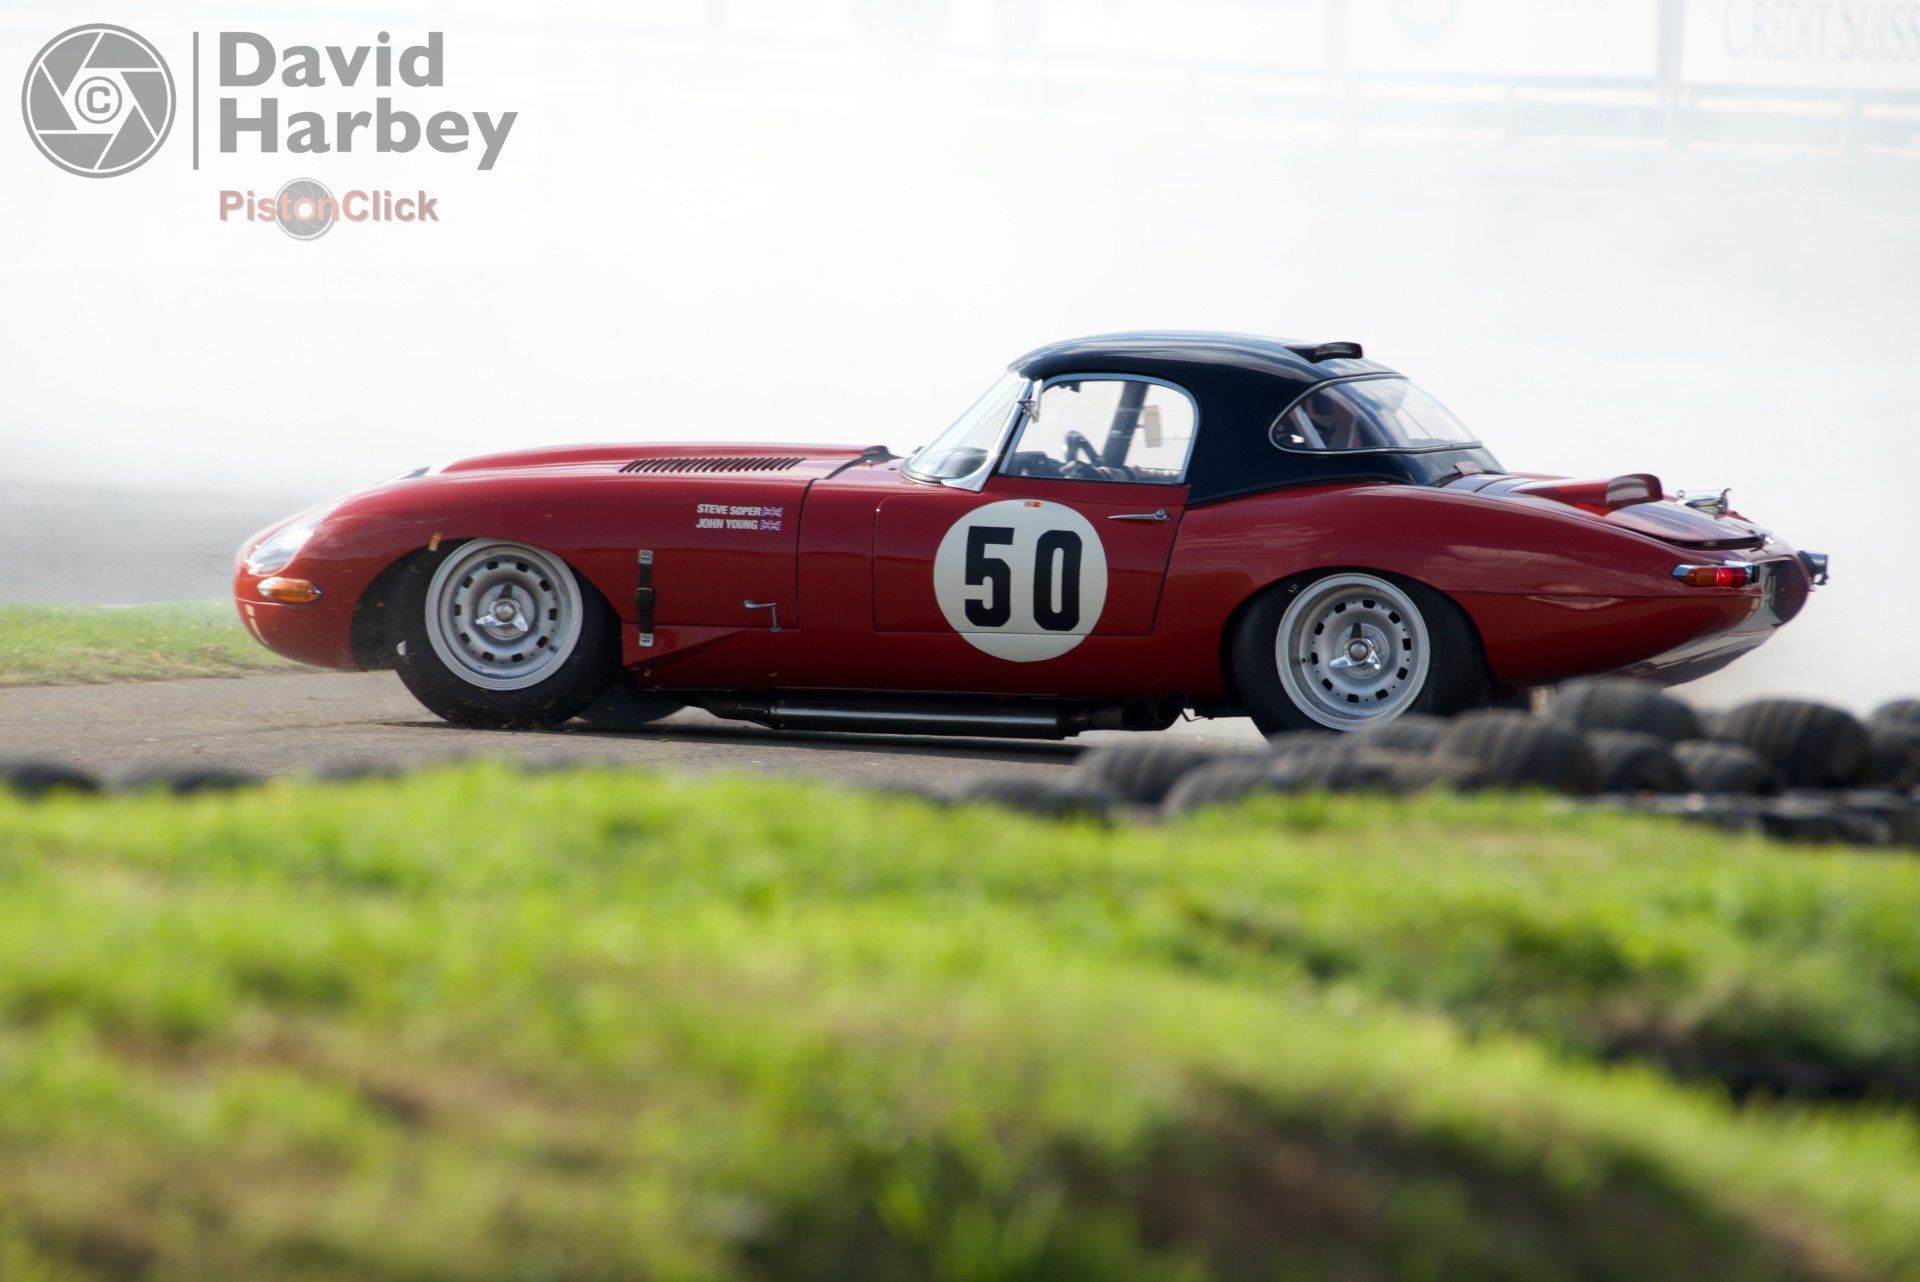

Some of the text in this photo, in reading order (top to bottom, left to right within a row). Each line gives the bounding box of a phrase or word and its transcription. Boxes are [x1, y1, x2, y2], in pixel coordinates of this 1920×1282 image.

[696, 503, 761, 516] STEVE SOPER
[695, 518, 759, 530] JOHN YOUNG
[964, 525, 1083, 632] 50
